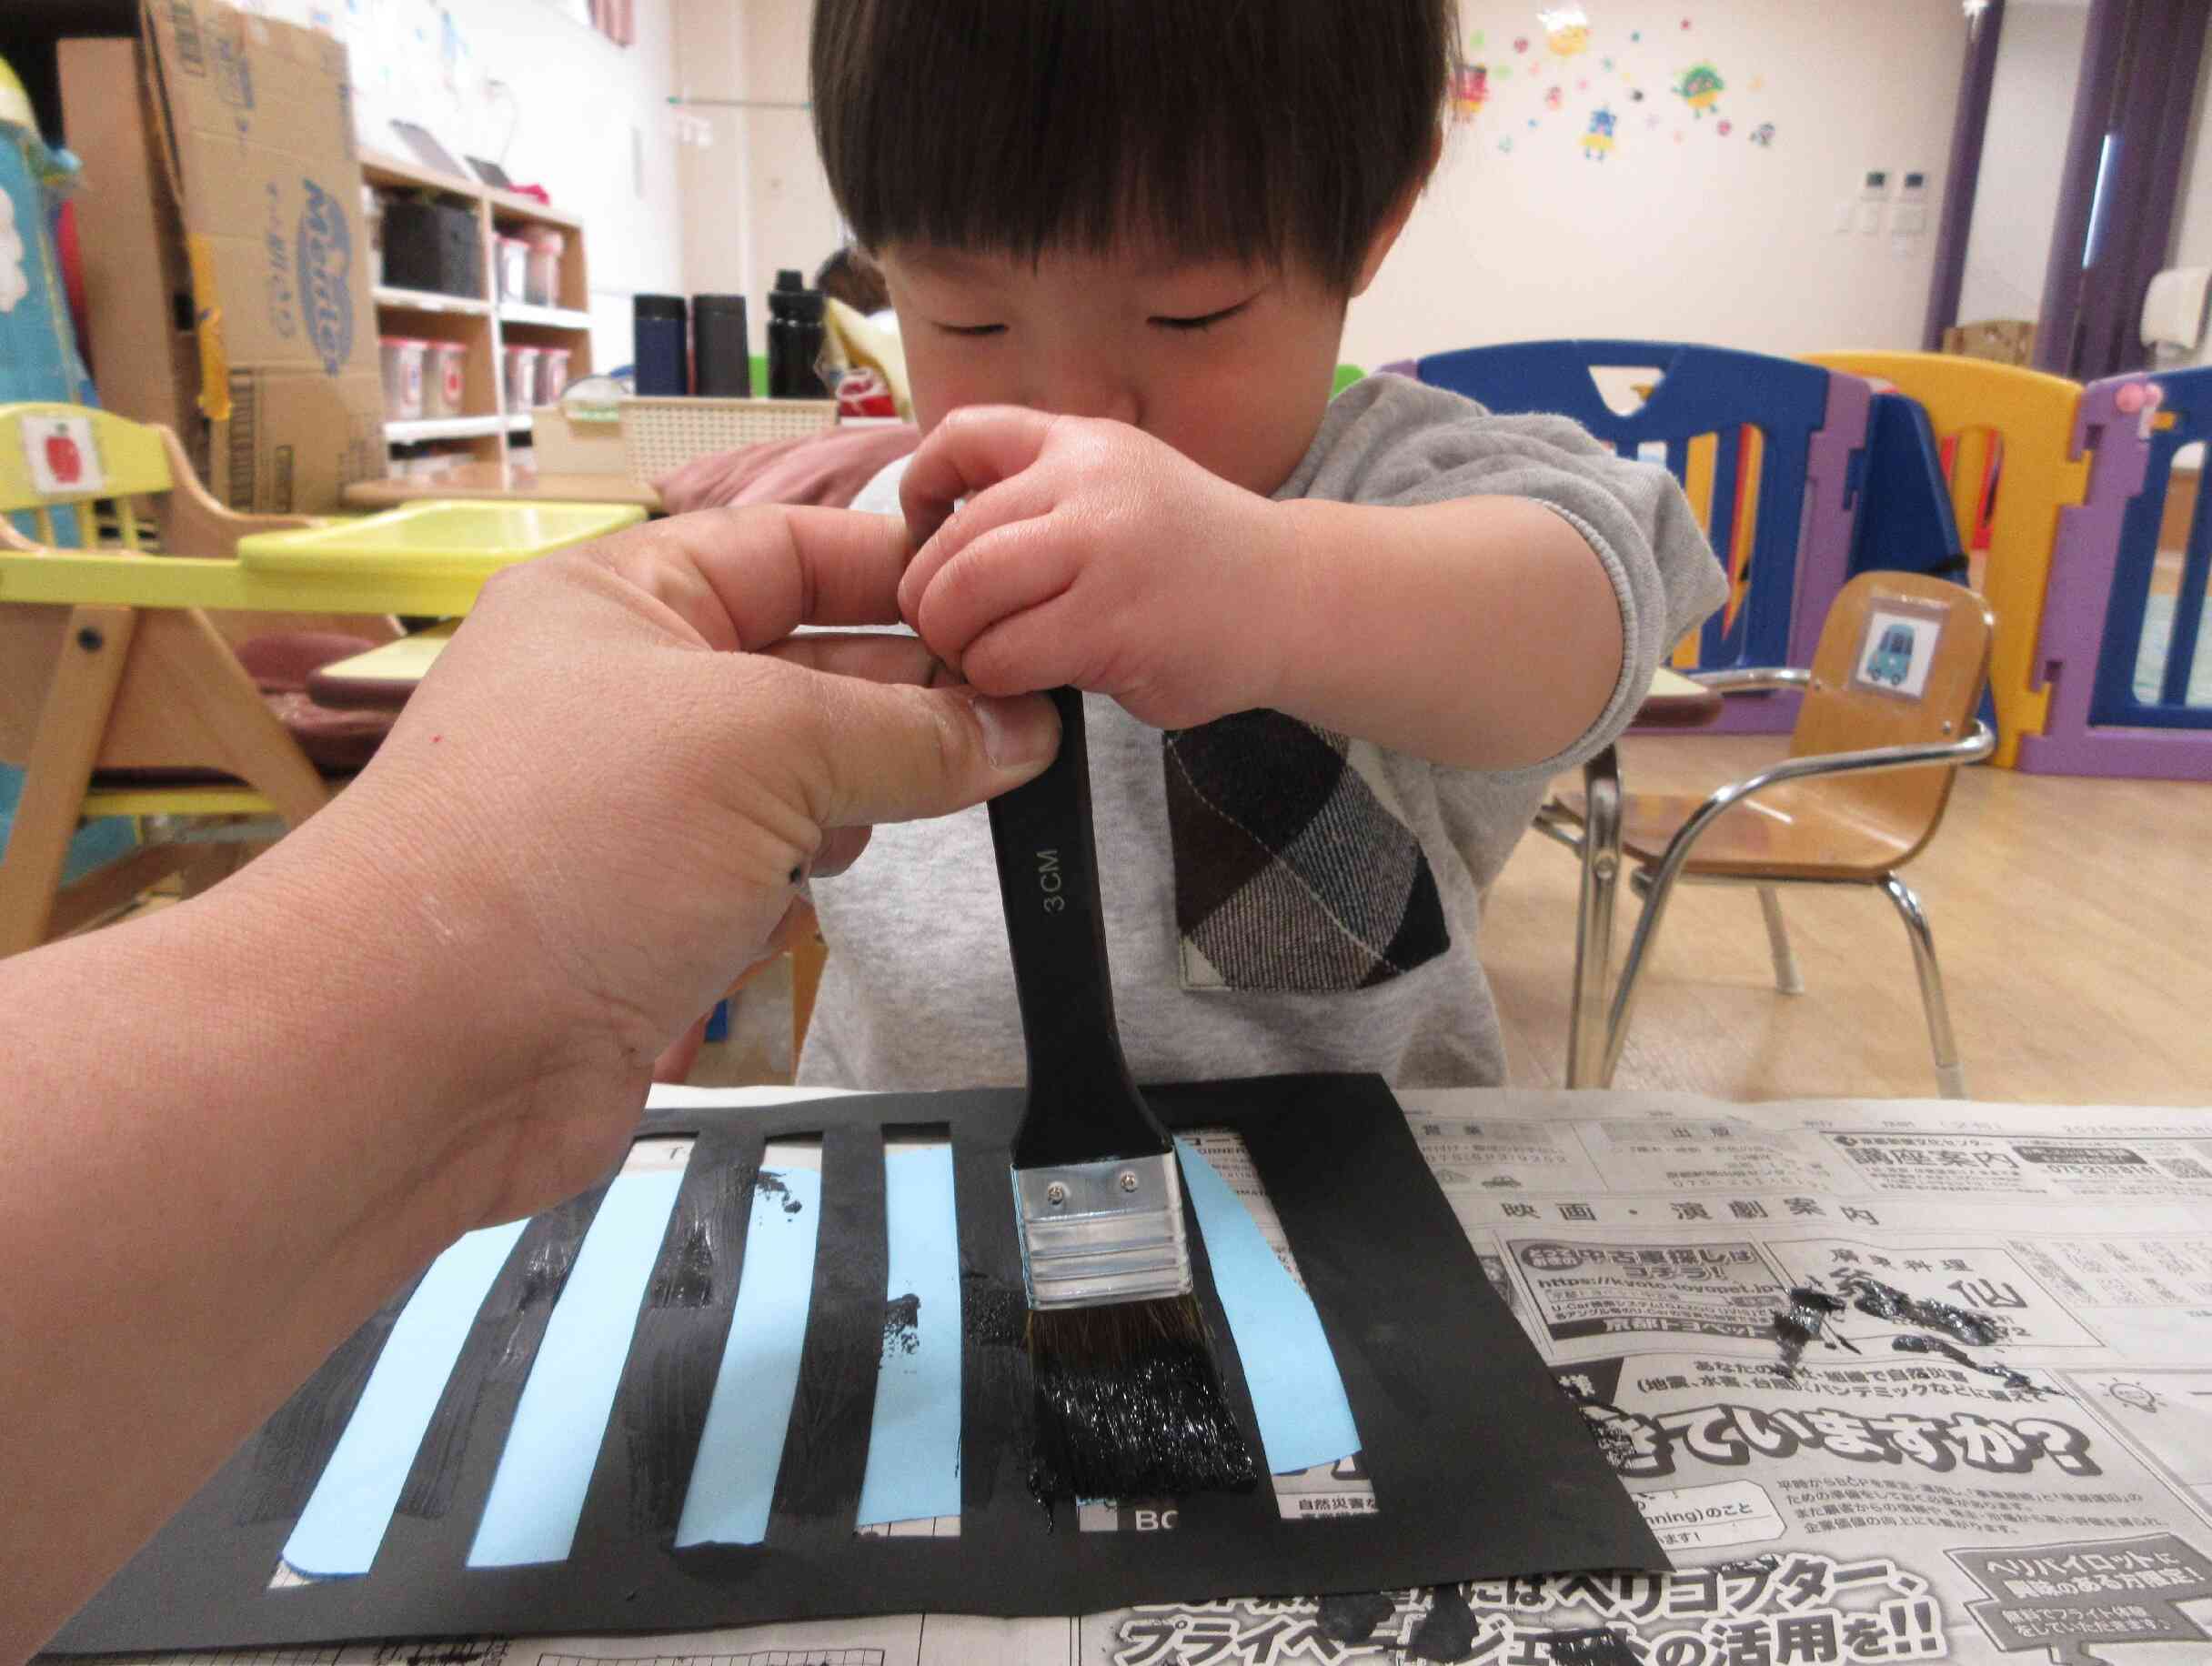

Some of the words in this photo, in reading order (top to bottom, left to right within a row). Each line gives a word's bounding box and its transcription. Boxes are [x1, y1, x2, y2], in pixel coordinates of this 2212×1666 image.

[1035, 848, 1066, 913] 3CM
[1845, 1147, 2020, 1171] 講座案内
[1501, 1196, 1880, 1226] 映画・演劇案内
[1986, 1550, 2181, 1577] ヘリパイロットに
